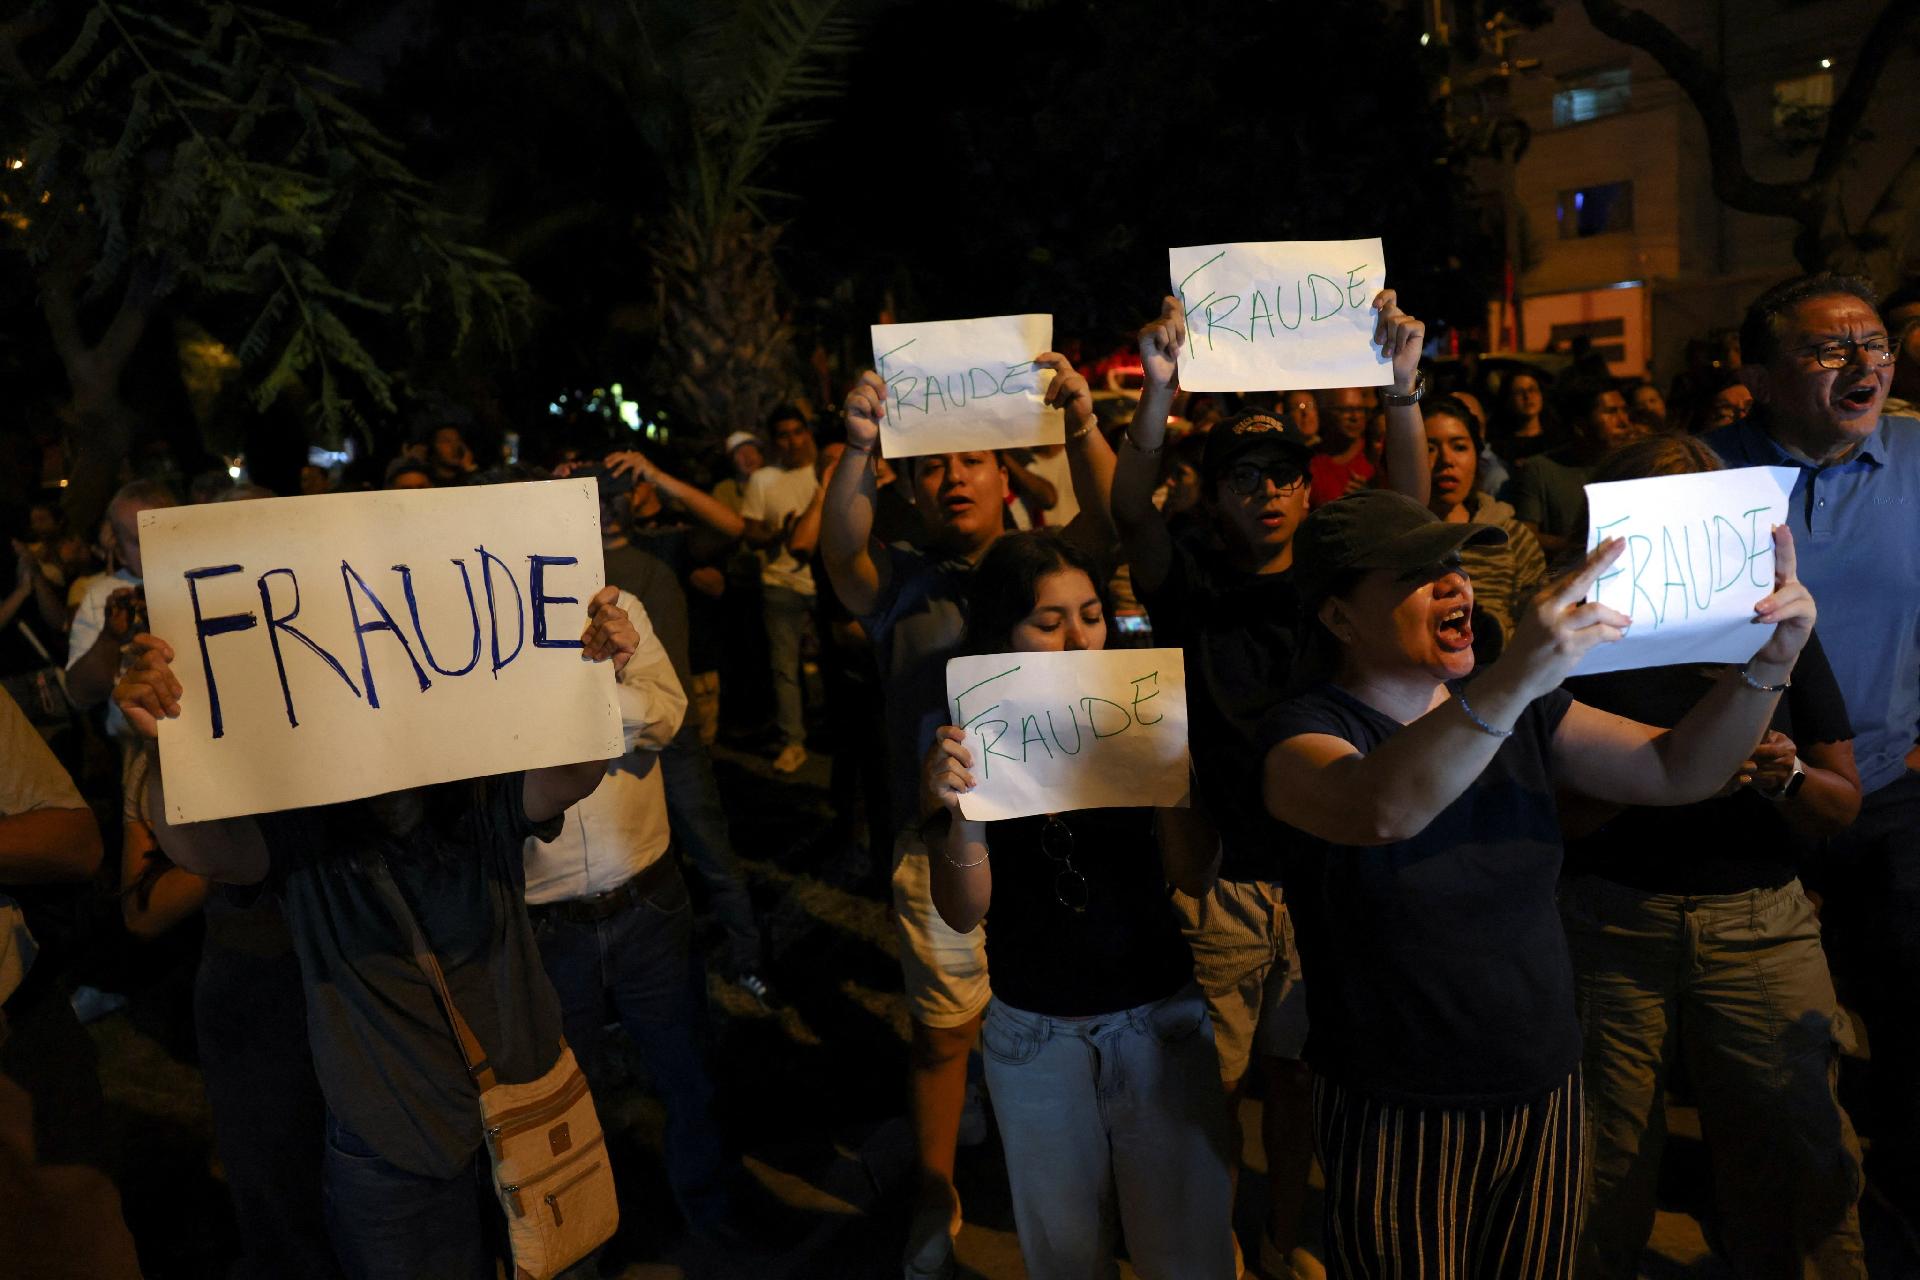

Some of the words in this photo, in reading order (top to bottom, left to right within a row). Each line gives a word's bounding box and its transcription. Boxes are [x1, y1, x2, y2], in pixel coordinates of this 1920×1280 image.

[1179, 251, 1368, 359] FRAUDE
[879, 338, 1037, 426] FRAUDE
[1595, 506, 1772, 637] FRAUDE
[184, 545, 586, 738] FRAUDE
[955, 665, 1163, 779] FRAUDE
